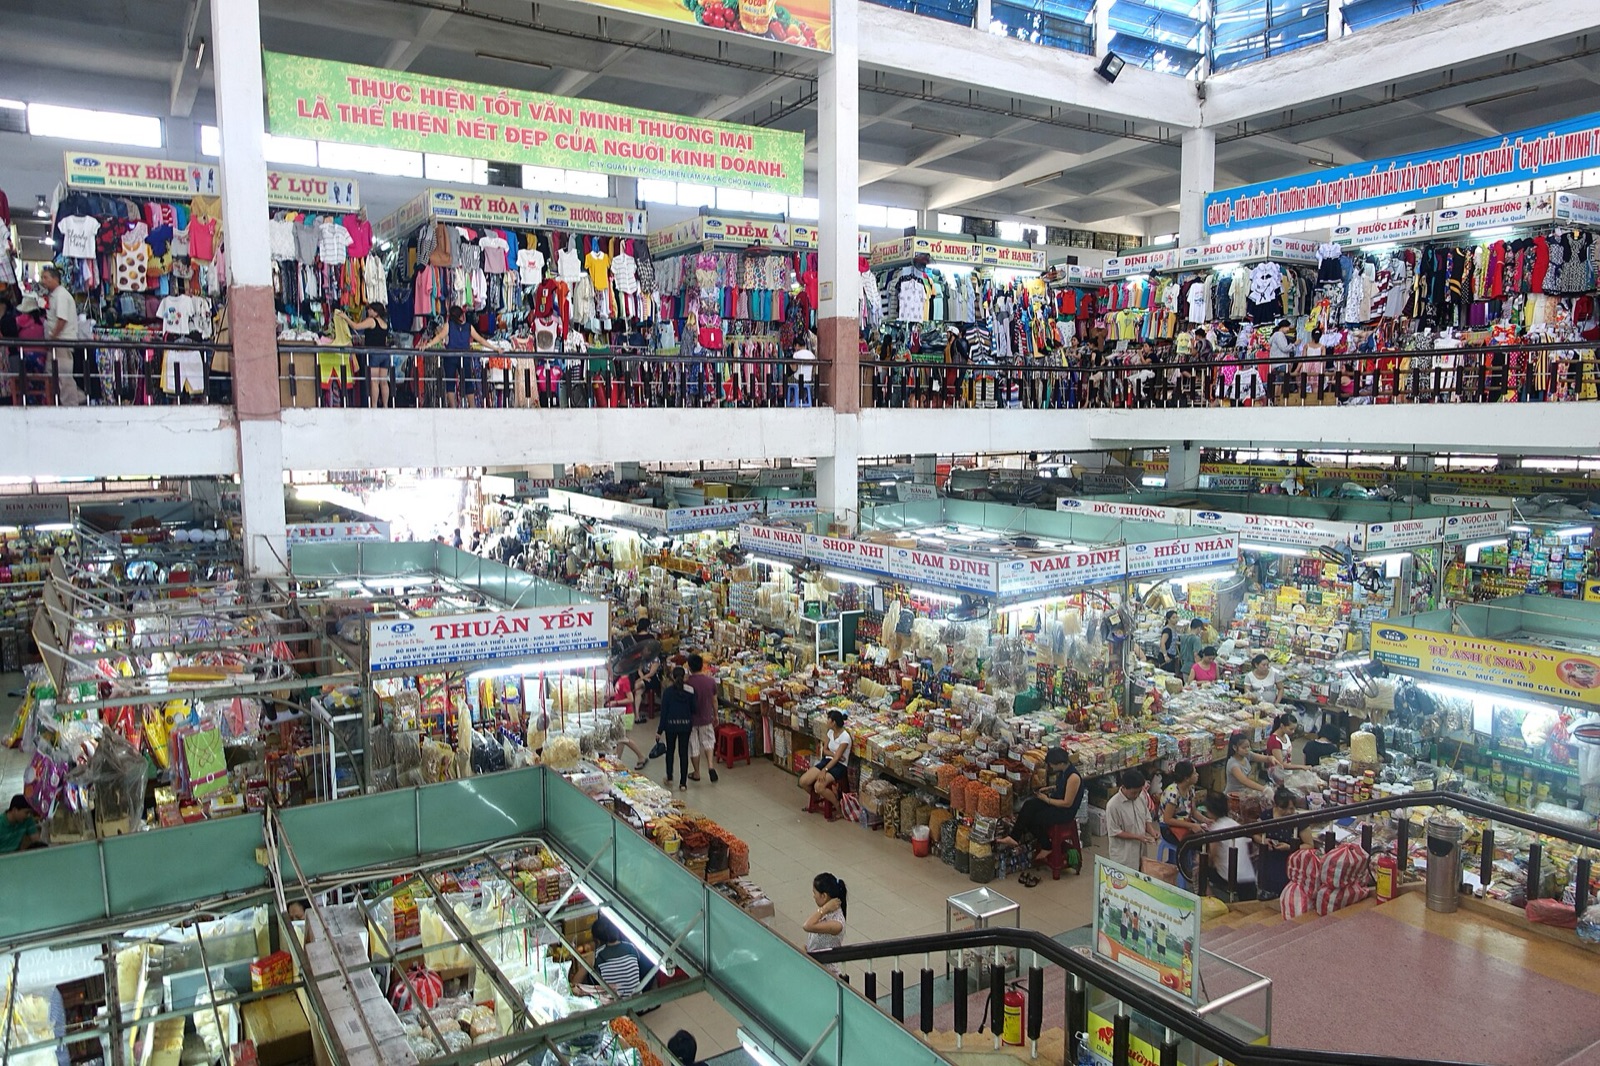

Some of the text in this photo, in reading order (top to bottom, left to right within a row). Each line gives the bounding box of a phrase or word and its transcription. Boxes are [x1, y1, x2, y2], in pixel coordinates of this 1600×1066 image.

[347, 76, 753, 153] THỰC HIỆN TỐT VĂN MINH THƯƠNG MẠI
[297, 96, 787, 178] LÀ THỂ HIỆN NÉT ĐẸP CỦA NGƯỜI KINH DOANH.
[105, 162, 140, 178] THY
[1235, 195, 1249, 221] VIÊN
[1251, 190, 1269, 219] CHỨC
[1270, 188, 1278, 216] VÀ
[1279, 186, 1306, 214] THƯƠNG
[1307, 180, 1326, 208] NHÂN
[1328, 179, 1342, 209] CHỢ
[1344, 173, 1359, 202] HÀN
[1400, 164, 1418, 191] XÂY
[1442, 153, 1460, 188] CHỢ
[1463, 152, 1481, 185] ĐẠT
[1542, 132, 1563, 166] VĂN
[1564, 131, 1591, 161] MINH
[487, 197, 519, 214] HÒA
[1489, 201, 1522, 215] PHƯƠNG
[570, 207, 603, 224] HƯƠNG
[606, 211, 623, 225] SEN
[944, 245, 967, 256] MINH
[1203, 244, 1222, 255] PHÚ
[1263, 517, 1315, 529] NHUNG
[1482, 513, 1498, 522] ANH
[752, 527, 770, 539] MAI
[822, 539, 884, 558] SHOP NHI
[1154, 537, 1234, 558] HIẾU NHÂN
[911, 551, 990, 577] NAM ĐỊNH
[1030, 556, 1070, 573] NAM
[1077, 549, 1121, 568] ĐỊNH
[430, 607, 594, 640] THUẬN YẾN
[1413, 634, 1437, 643] GIA
[1432, 665, 1449, 673] TÔM
[1476, 673, 1494, 682] MỰC
[1538, 684, 1556, 693] CÁC
